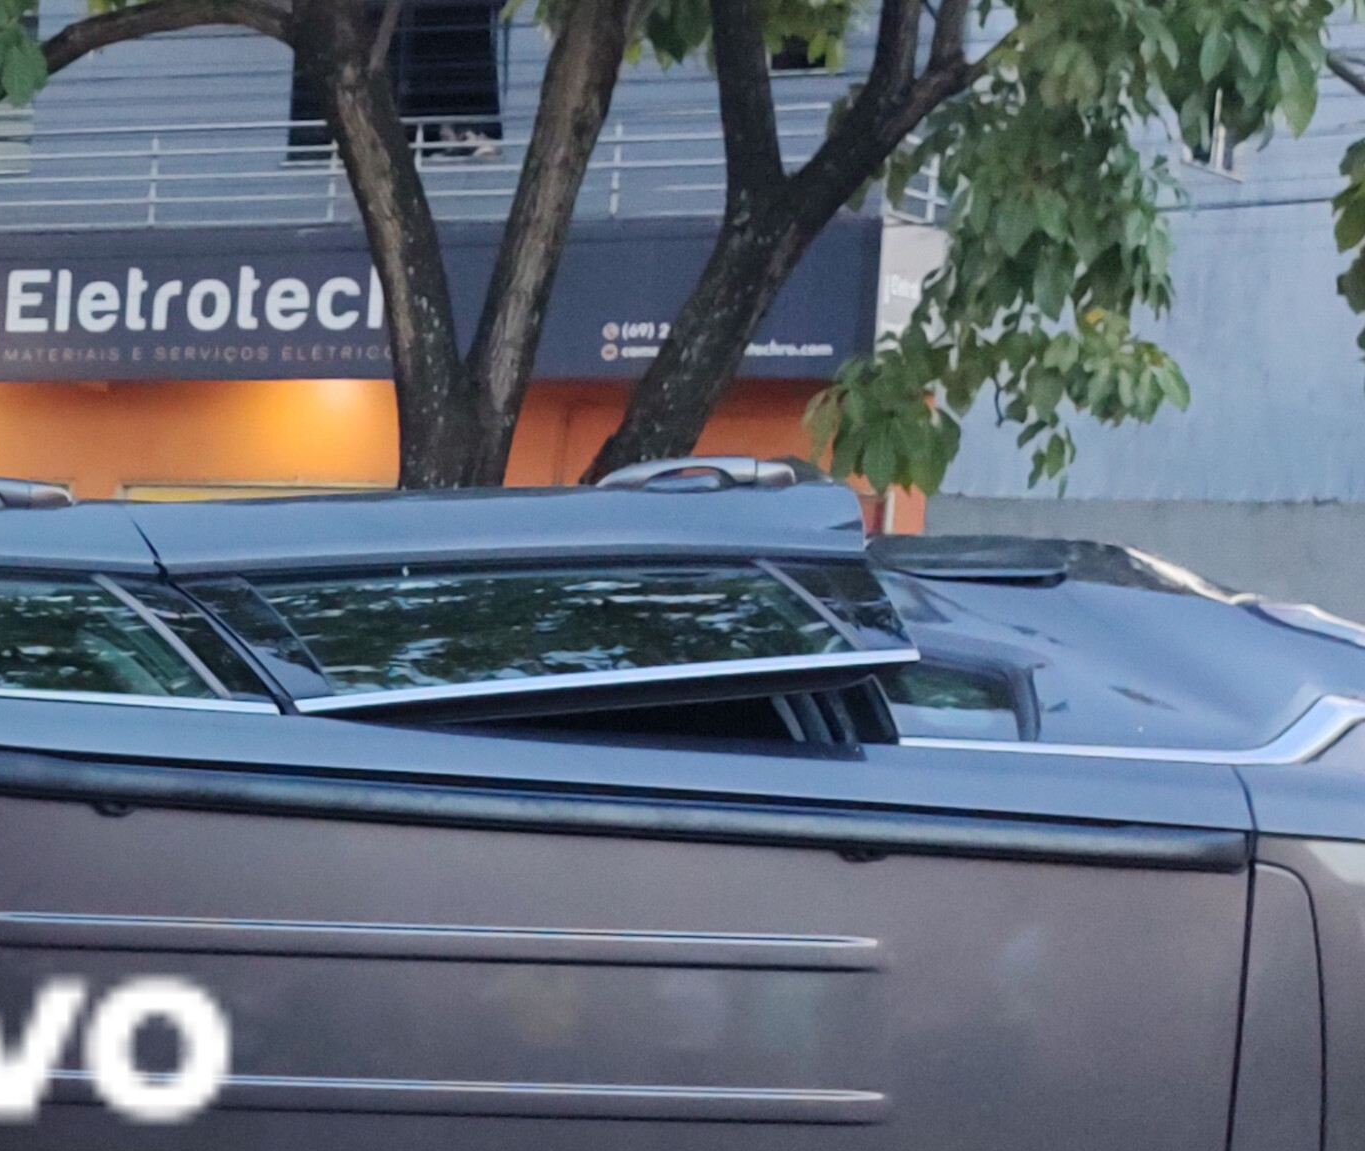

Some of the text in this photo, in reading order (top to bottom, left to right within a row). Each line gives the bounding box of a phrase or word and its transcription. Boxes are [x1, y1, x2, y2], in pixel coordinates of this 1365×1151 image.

[4, 346, 120, 361] MATERIAIS
[132, 346, 143, 361] E
[154, 345, 268, 363] SERVIÇOS
